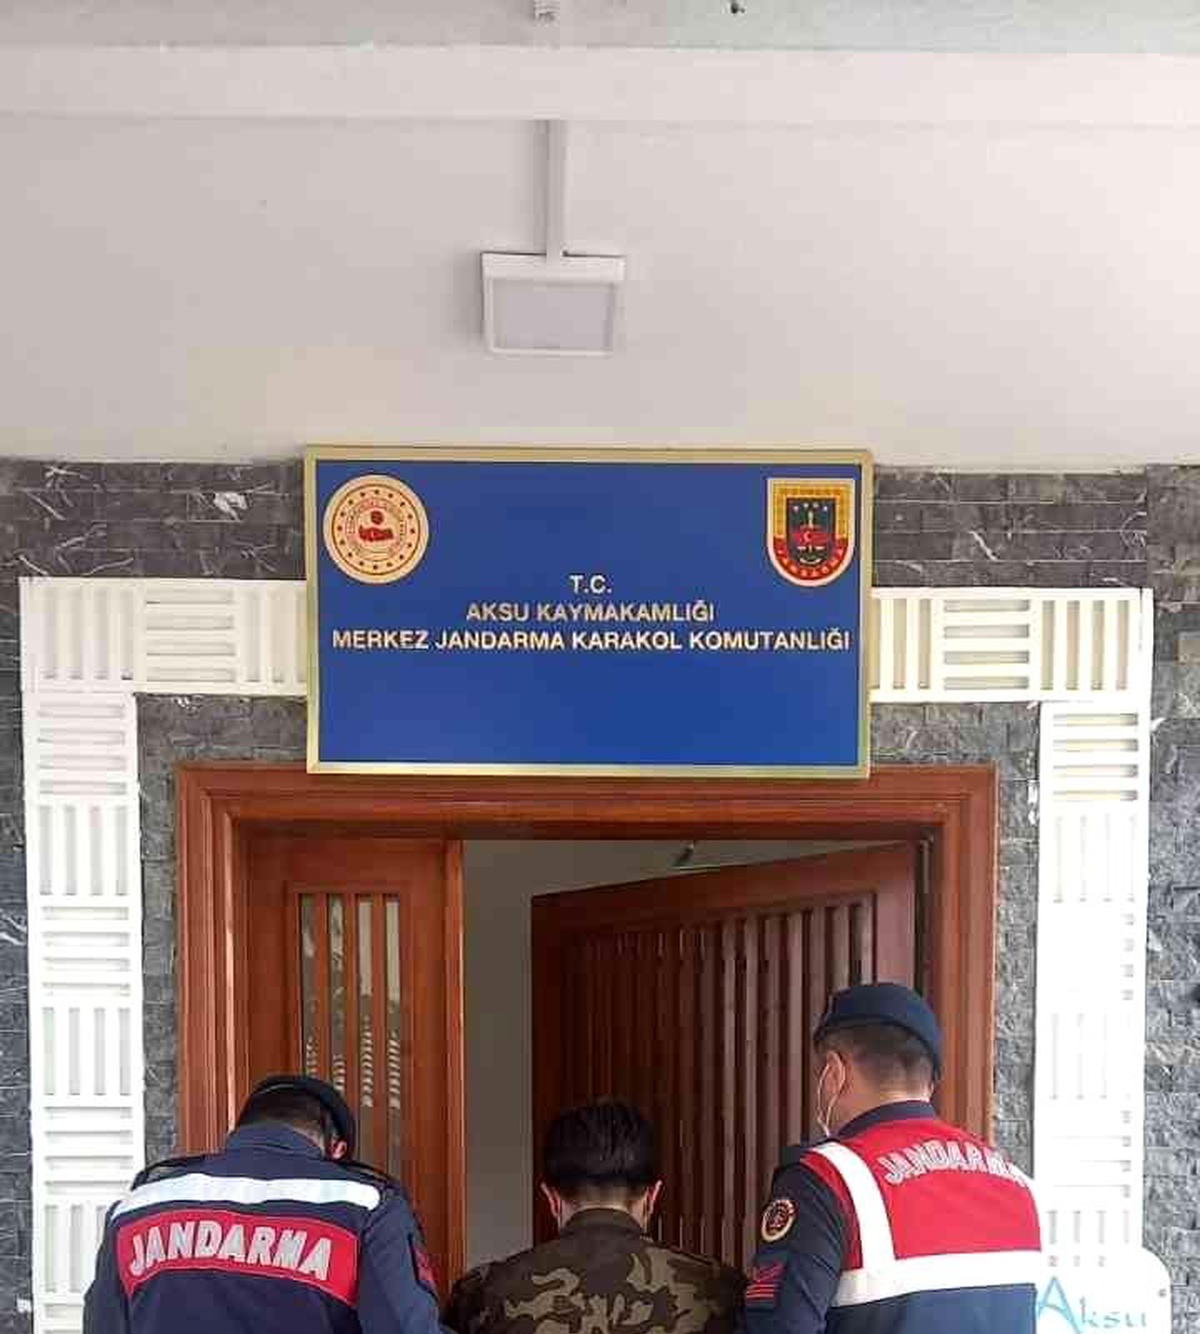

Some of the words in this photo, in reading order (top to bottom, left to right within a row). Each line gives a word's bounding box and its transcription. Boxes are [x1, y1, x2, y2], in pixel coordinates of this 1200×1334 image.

[570, 575, 612, 594] T.C.
[466, 603, 529, 622] AKSU
[537, 600, 714, 622] KAYMAKAMLIĞI
[332, 630, 429, 649] MERKEZ
[436, 631, 565, 650] JANDARMA
[572, 631, 682, 649] KARAKOL
[689, 627, 850, 650] KOMUTANLIĞI
[129, 1219, 332, 1281] JANDARMA
